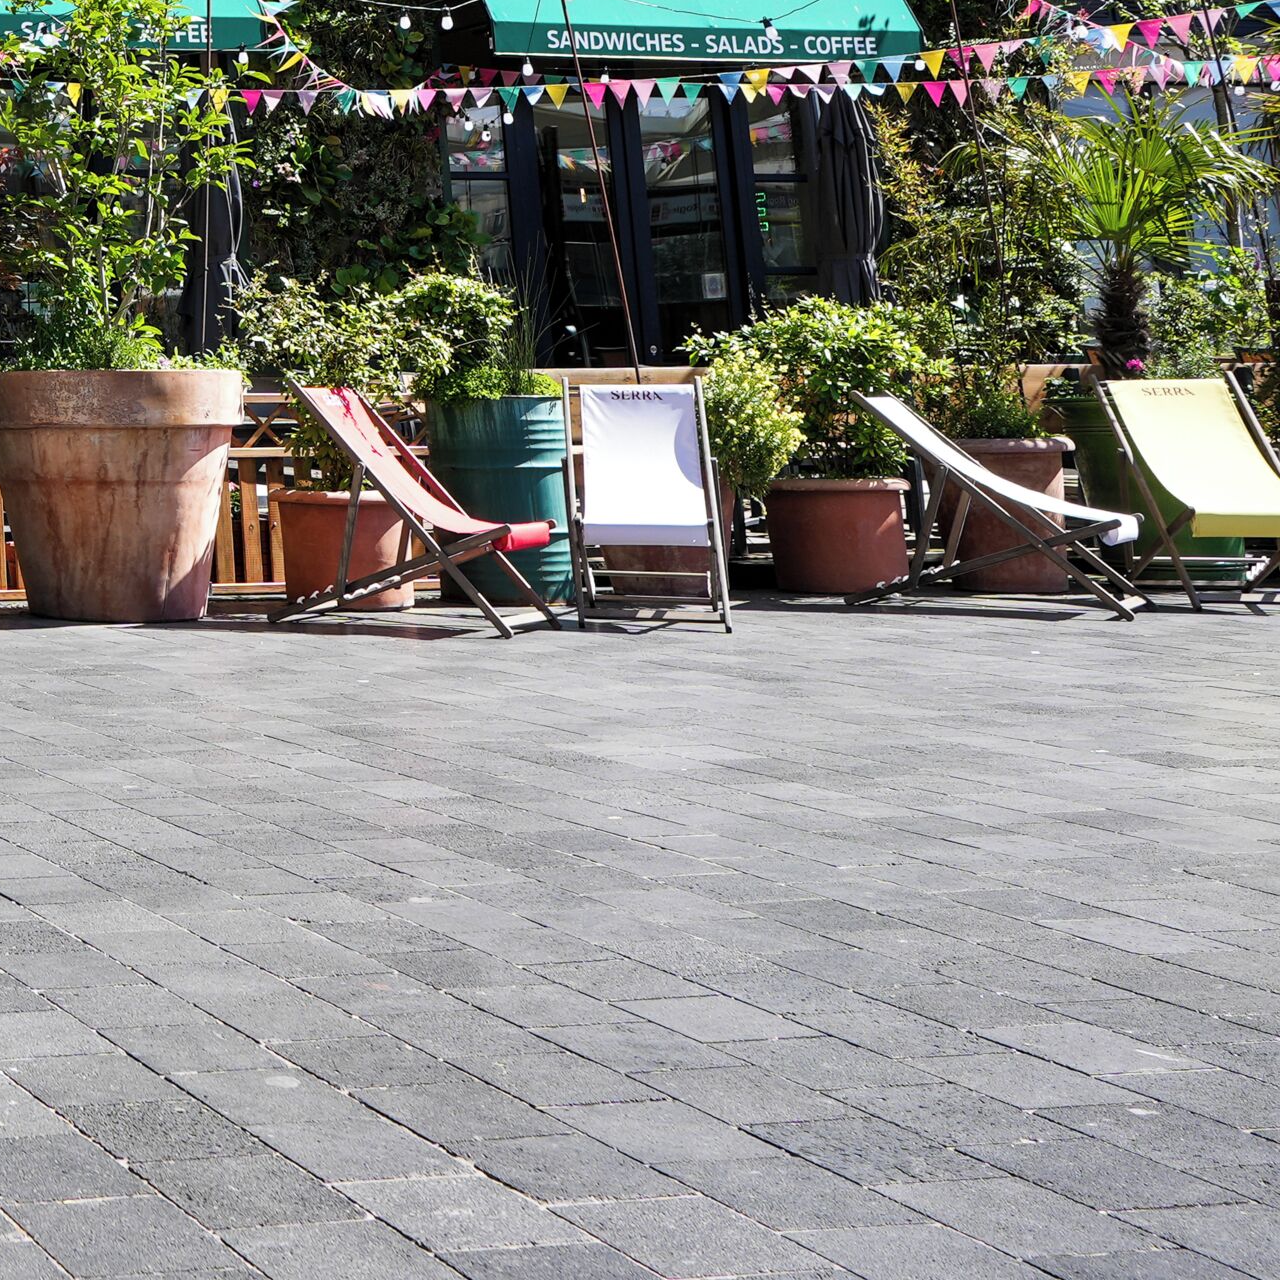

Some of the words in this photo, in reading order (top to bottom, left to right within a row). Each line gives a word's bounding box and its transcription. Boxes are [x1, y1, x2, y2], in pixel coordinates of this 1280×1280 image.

[547, 29, 685, 53] SANDWICHES
[706, 34, 784, 55] SALADS
[804, 35, 877, 55] COFFEE
[611, 390, 663, 401] SERRA
[1141, 387, 1196, 397] SERRA
